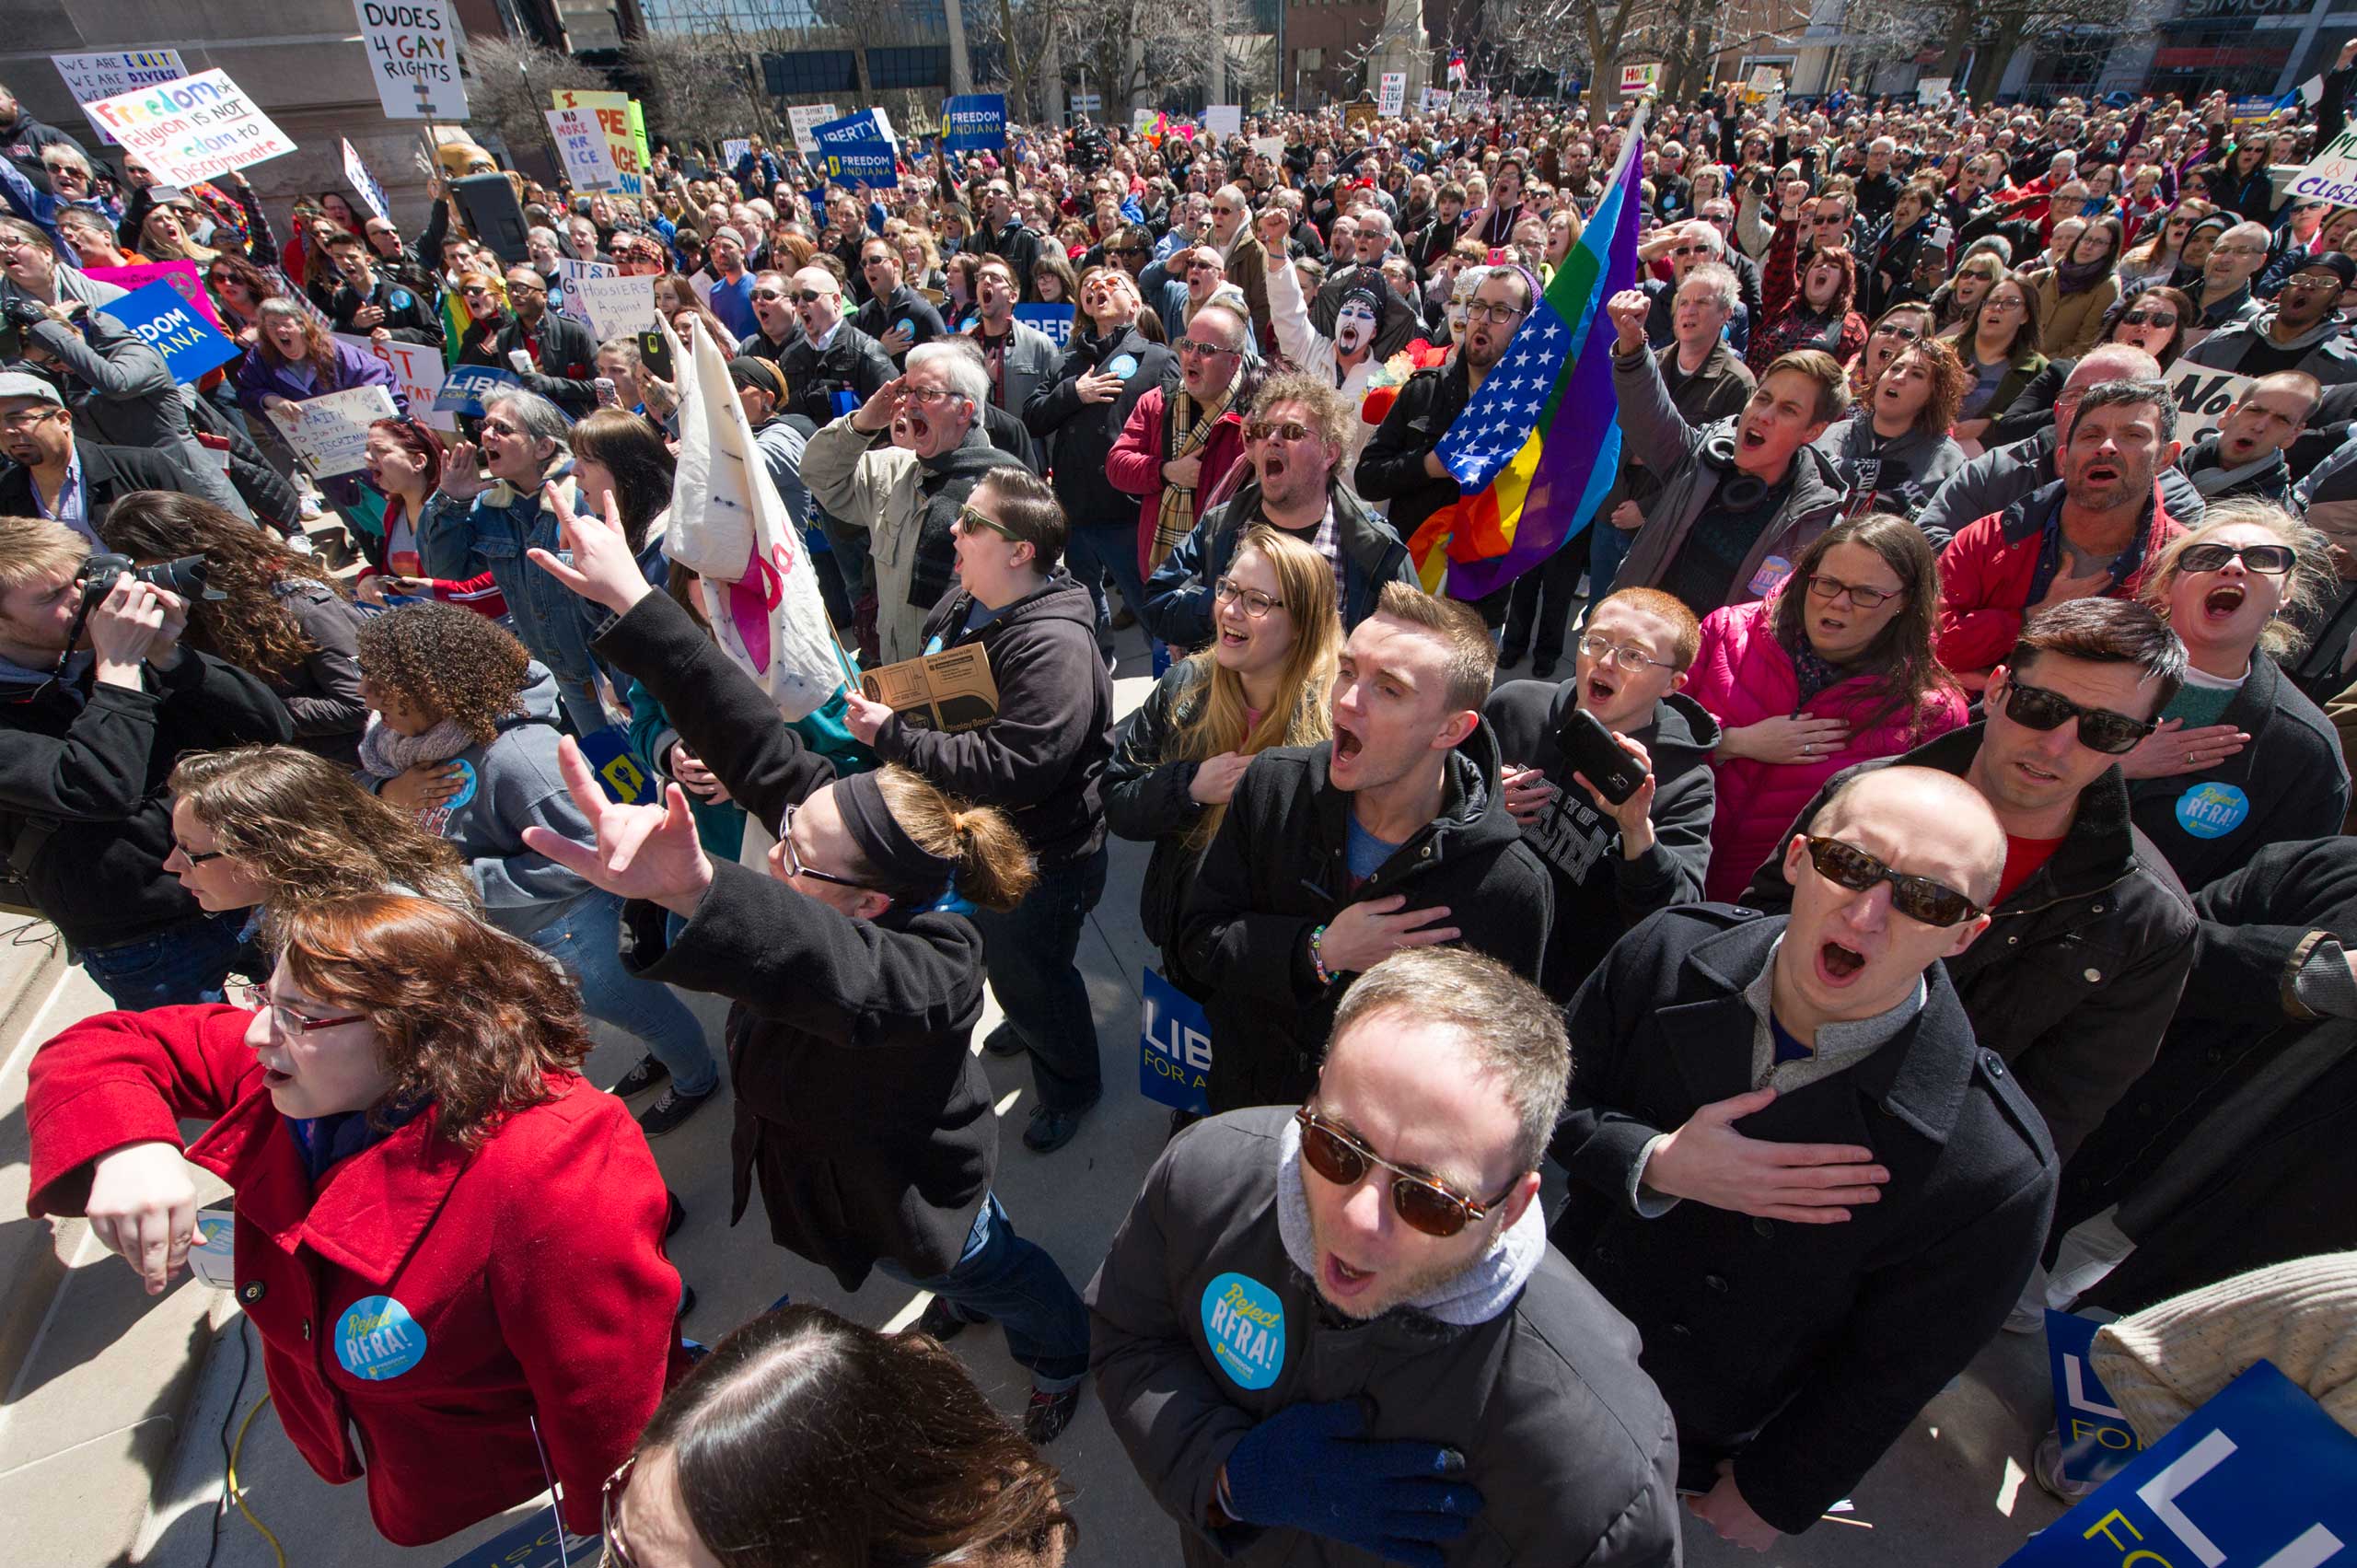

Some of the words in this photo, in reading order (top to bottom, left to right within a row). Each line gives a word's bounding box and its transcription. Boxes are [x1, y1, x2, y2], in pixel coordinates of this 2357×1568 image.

[364, 3, 441, 30] DUDES
[374, 35, 392, 60] 4
[397, 35, 446, 60] GAY
[59, 58, 88, 71] WE
[96, 57, 121, 69] ARE
[384, 61, 450, 82] RIGHTS
[68, 75, 93, 87] WE
[99, 73, 124, 86] ARE
[127, 69, 180, 83] DIVERSE
[95, 81, 222, 127] Freedom
[216, 78, 233, 94] of
[122, 118, 190, 148] religion
[214, 99, 246, 120] NOT
[556, 122, 588, 136] MORE
[562, 111, 576, 122] NO
[952, 111, 1001, 123] FREEDOM
[953, 123, 1002, 134] INDIANA
[145, 132, 238, 169] Freedom
[238, 124, 259, 140] to
[171, 139, 281, 182] Discriminate
[842, 156, 890, 166] FREEDOM
[843, 166, 891, 176] INDIANA
[2296, 177, 2357, 204] CLOSE
[305, 410, 346, 429] FAITH
[1576, 806, 1599, 827] OF
[2186, 797, 2239, 827] RFRA!
[1144, 1048, 1187, 1085] FOR
[1225, 1283, 1281, 1328] Reject
[348, 1307, 393, 1342] Reject
[1211, 1296, 1278, 1370] RFRA!
[345, 1324, 412, 1366] RFRA!
